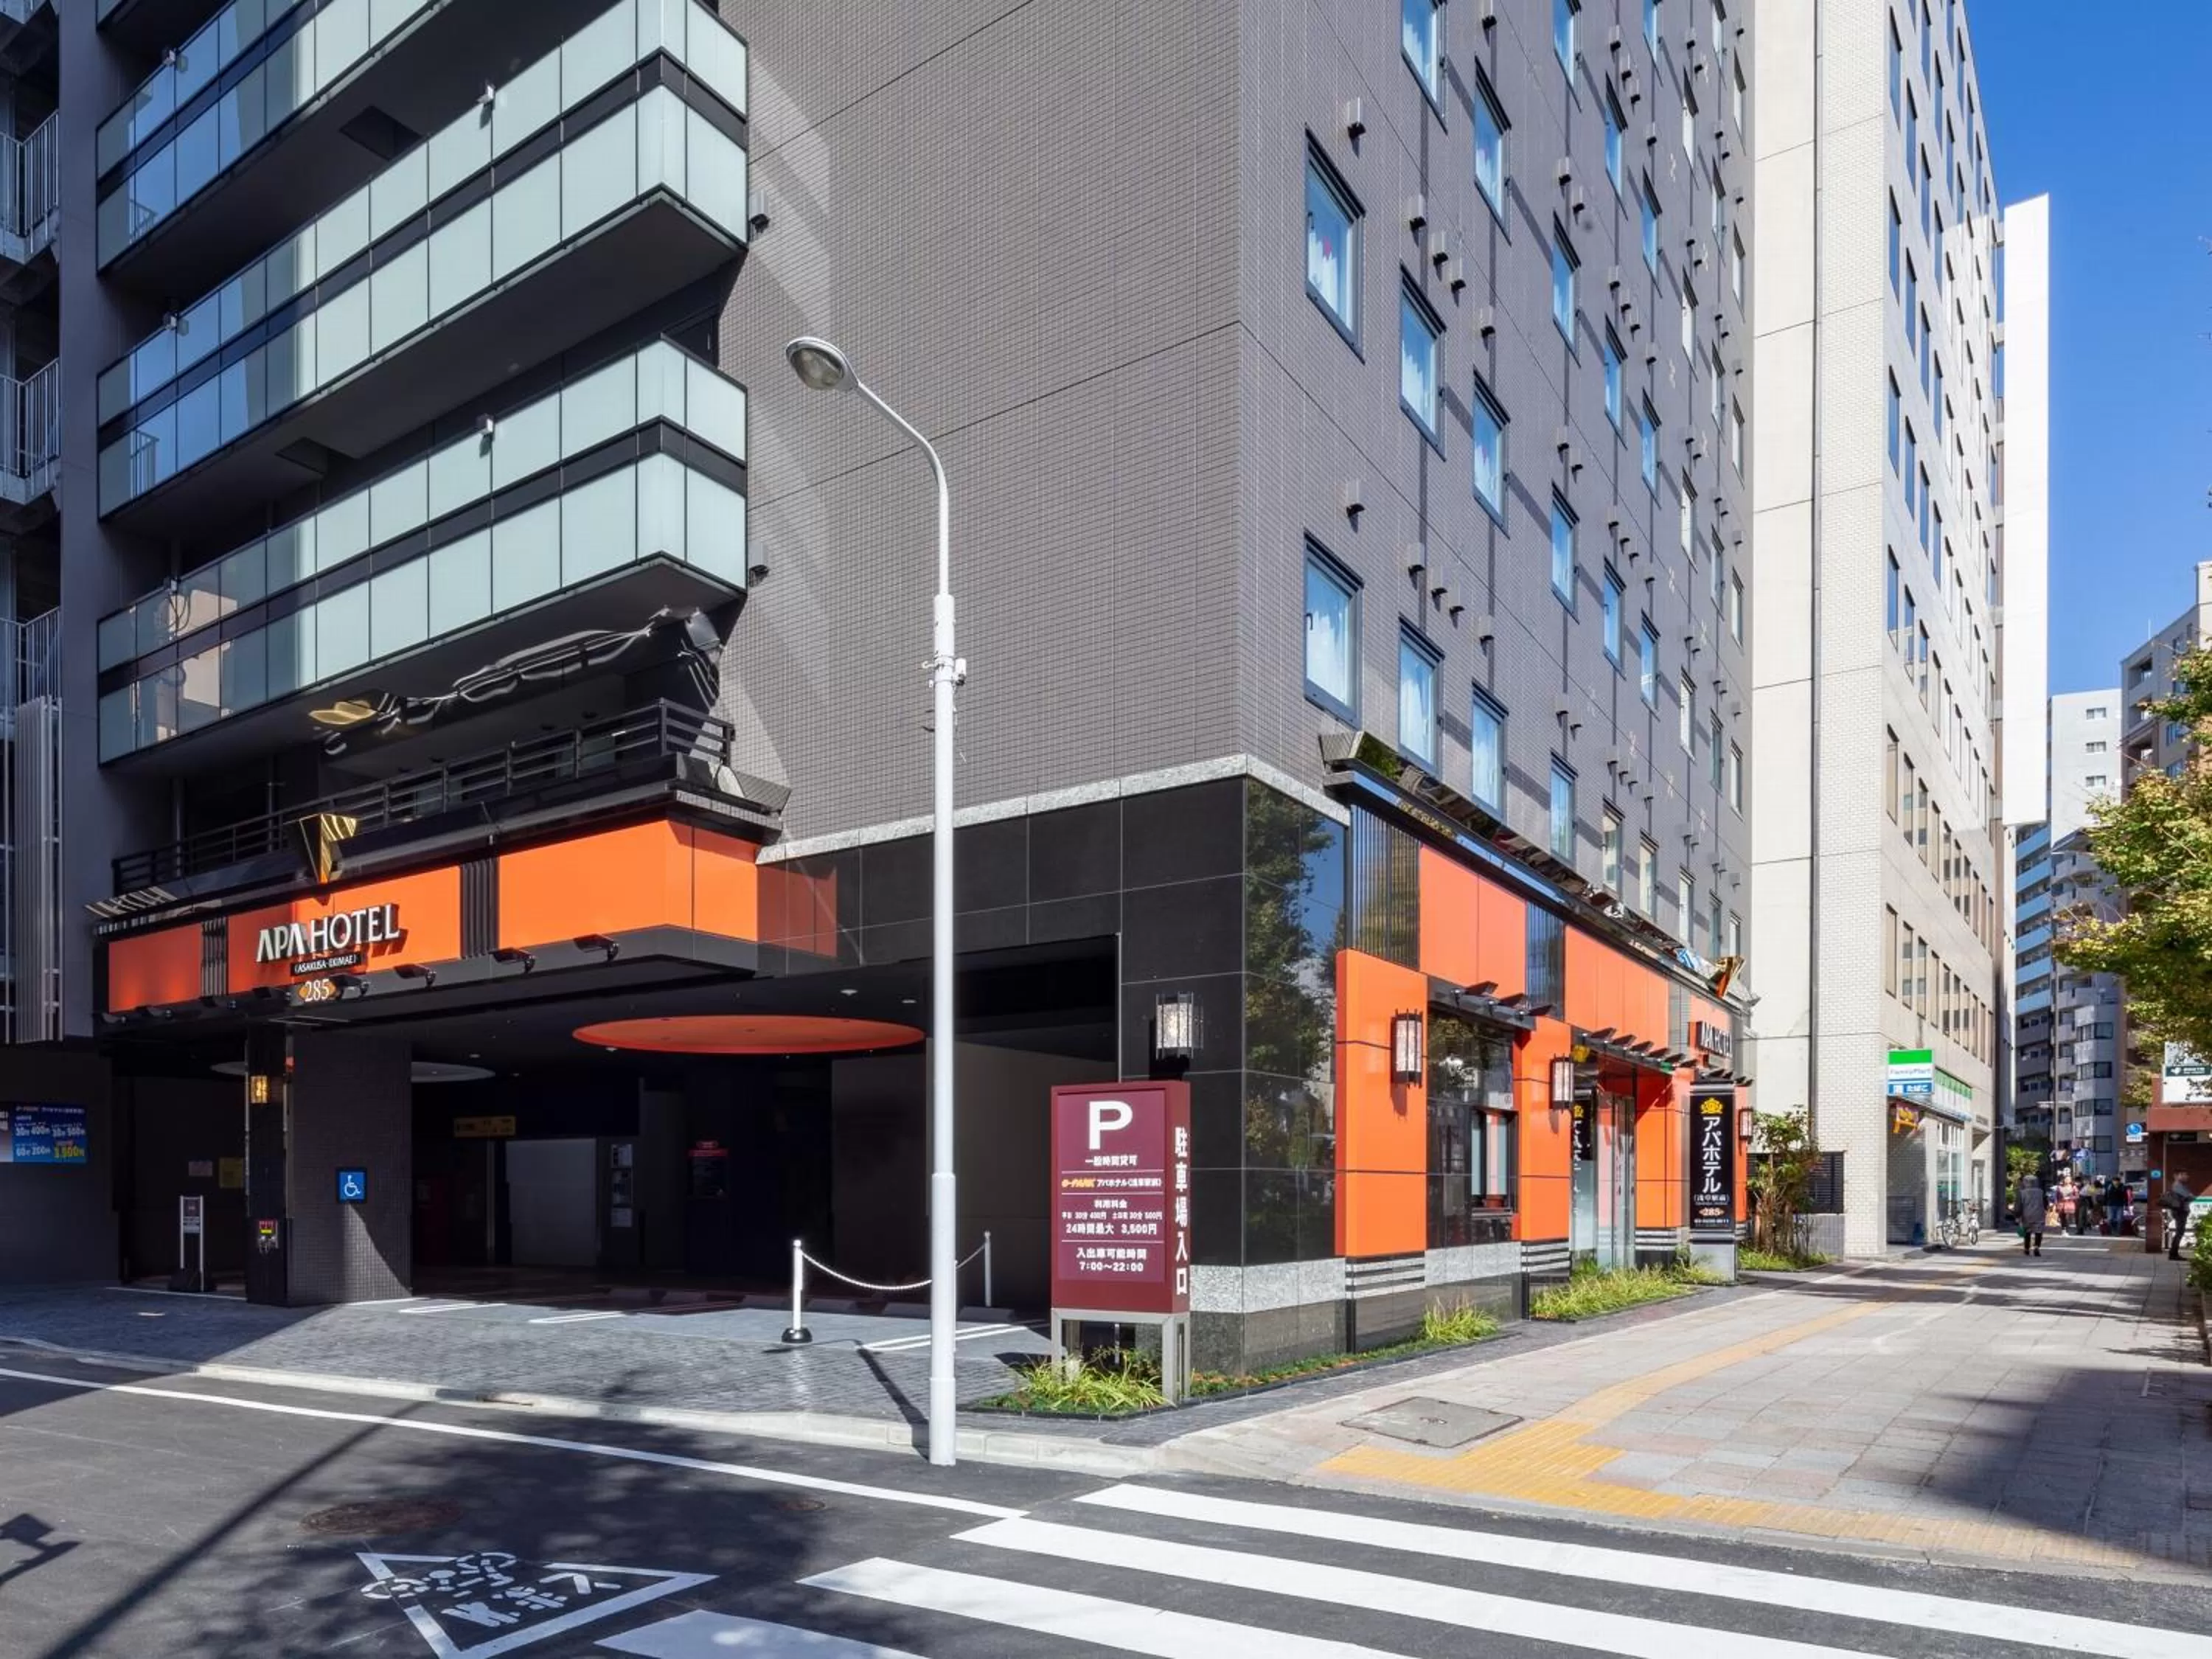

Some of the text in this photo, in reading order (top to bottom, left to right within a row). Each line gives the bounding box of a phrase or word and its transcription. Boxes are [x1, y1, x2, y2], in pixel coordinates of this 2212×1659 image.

[257, 903, 400, 962] APA HOTEL
[305, 978, 330, 1002] 285
[1089, 1100, 1133, 1150] P
[1702, 1116, 1722, 1193] アパホテル
[1065, 1223, 1114, 1234] 24時間最大
[1175, 1127, 1189, 1295] 駐車場入口
